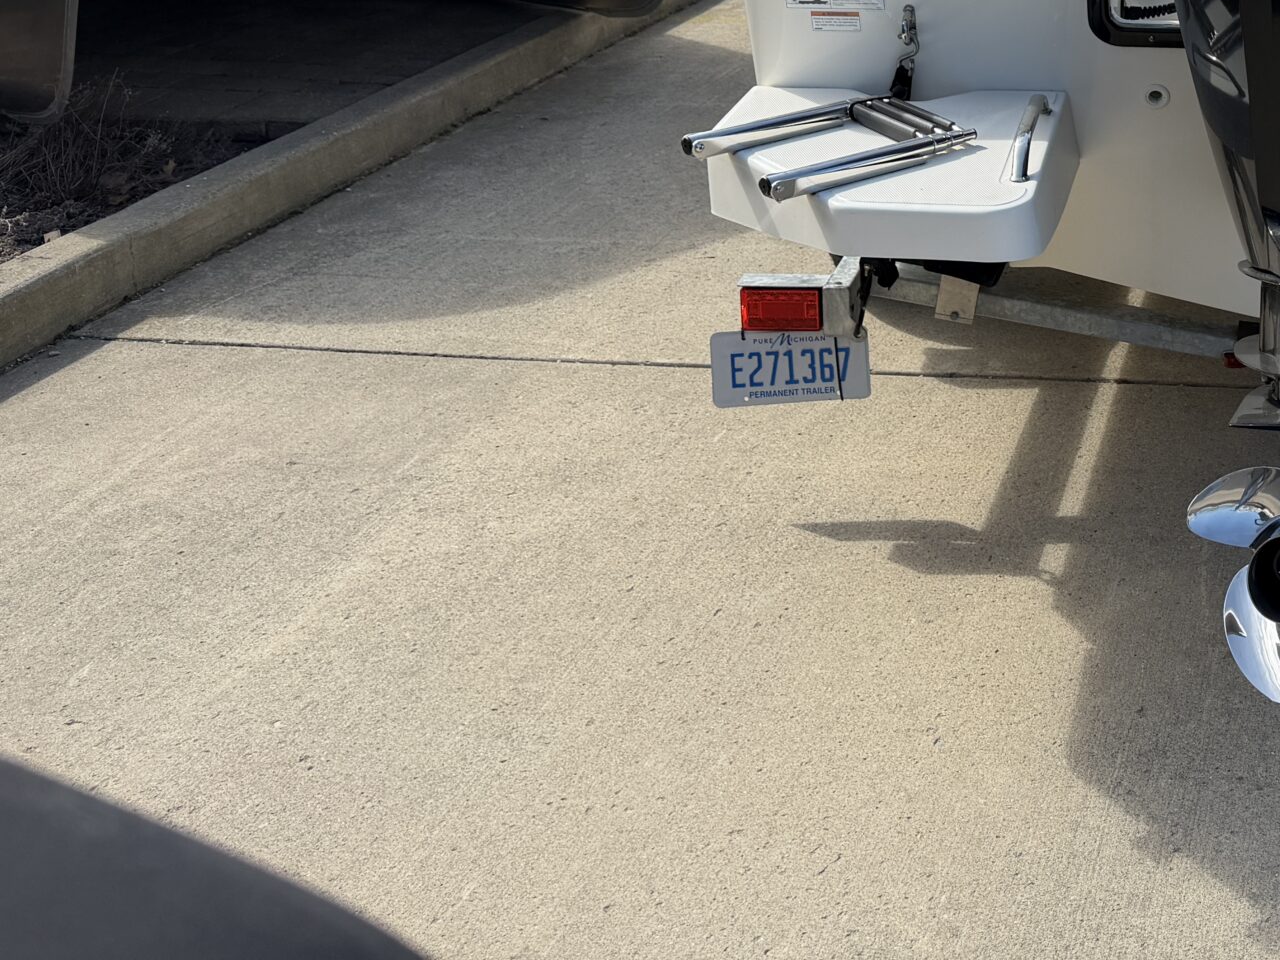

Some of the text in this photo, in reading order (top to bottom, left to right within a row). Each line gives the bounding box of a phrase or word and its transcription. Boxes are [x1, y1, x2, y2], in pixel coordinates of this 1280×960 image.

[753, 337, 774, 345] PURE
[730, 346, 850, 389] E271367
[749, 386, 836, 399] PERMANENT TRAILER
